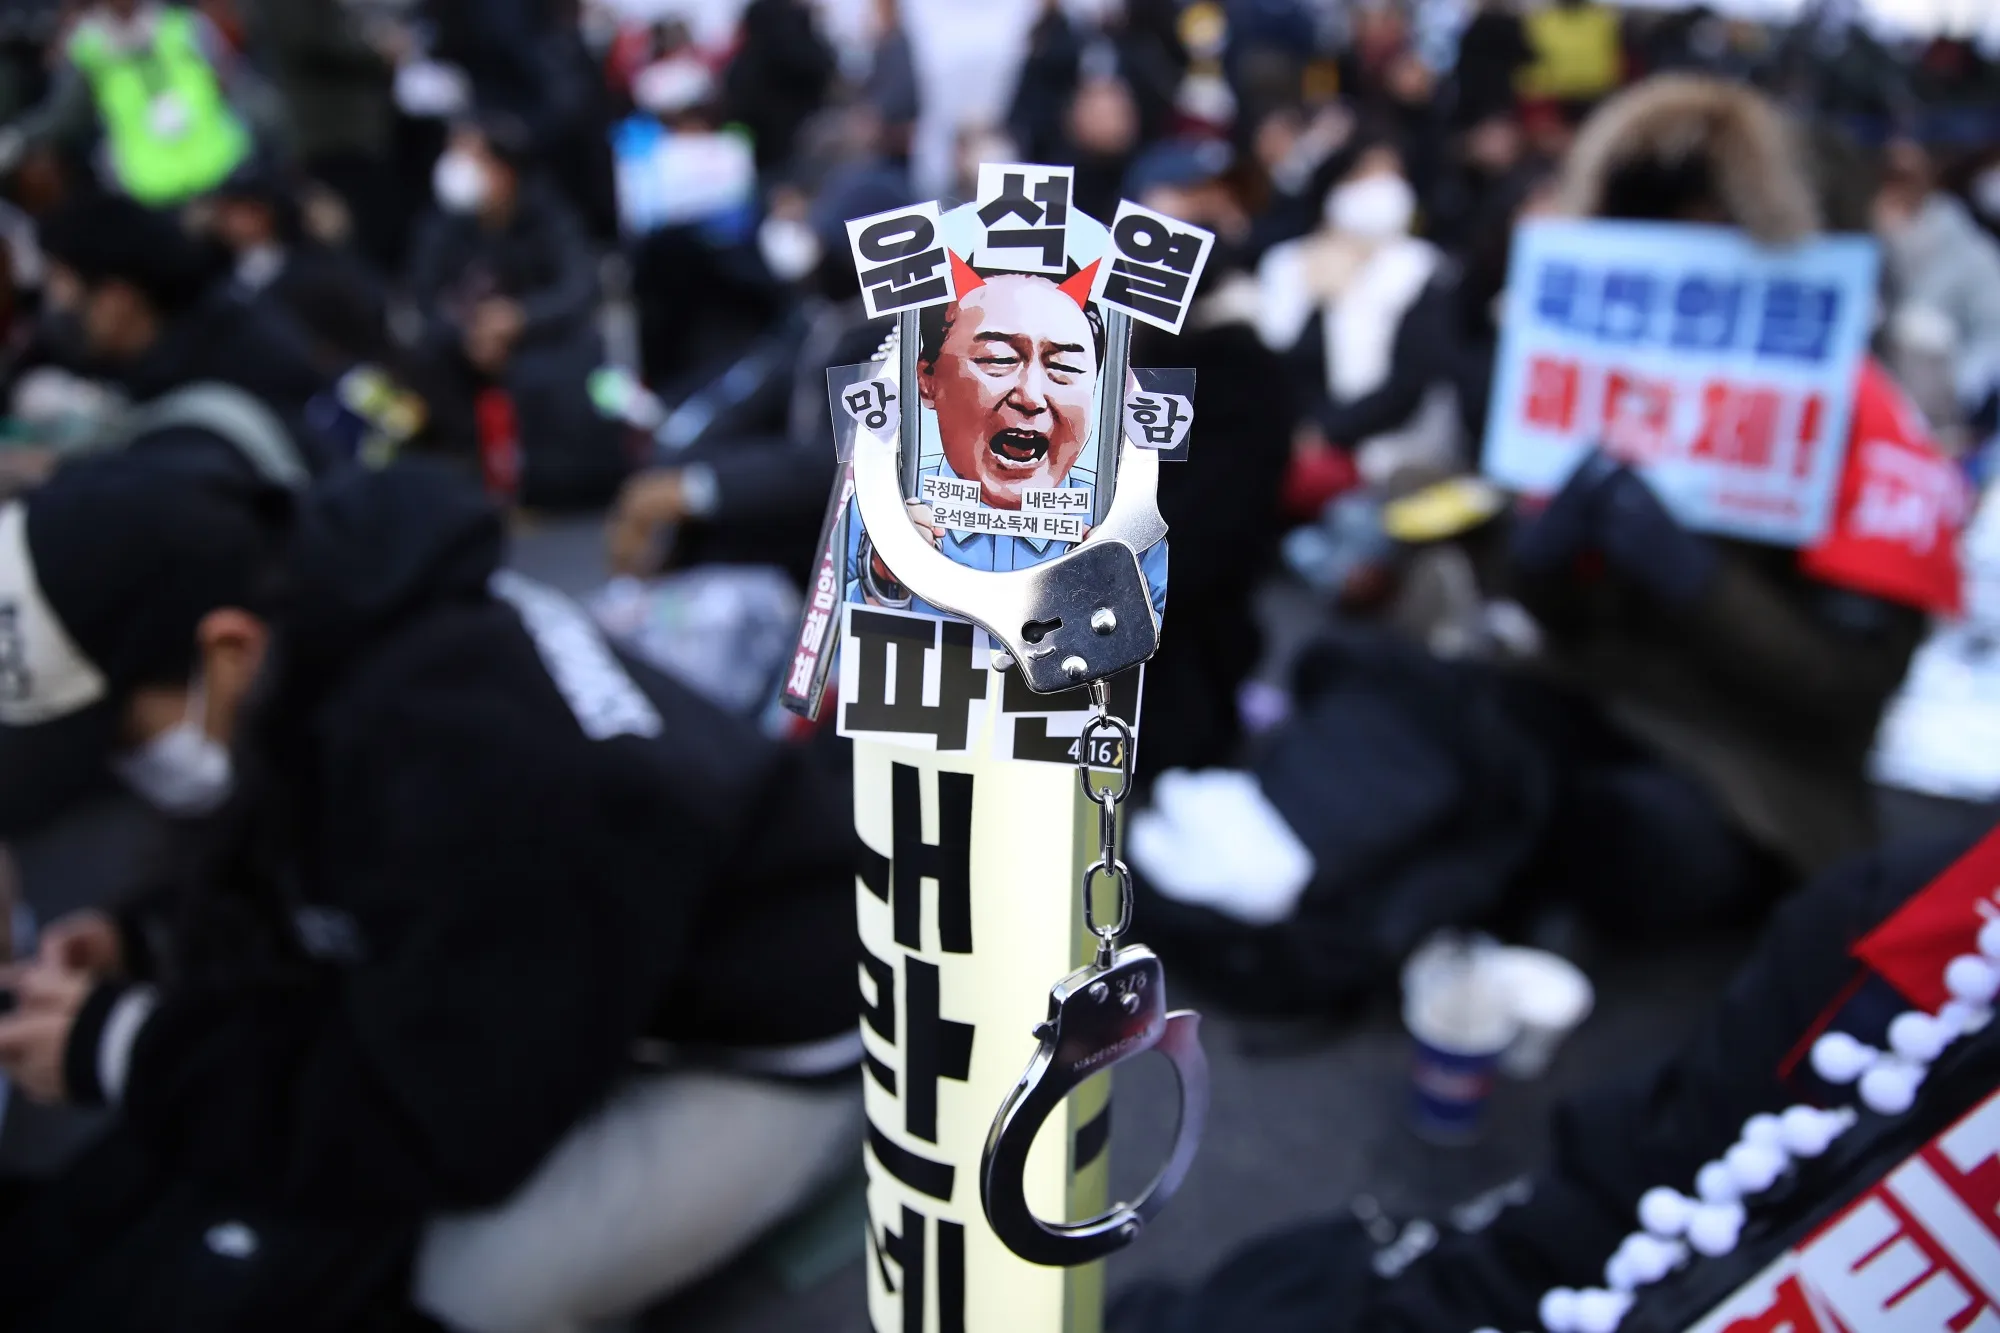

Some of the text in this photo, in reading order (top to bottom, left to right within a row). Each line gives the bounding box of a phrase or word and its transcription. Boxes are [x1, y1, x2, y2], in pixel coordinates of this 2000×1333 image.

[857, 172, 1203, 325] 윤석열
[923, 479, 980, 504] 국정파괴
[1026, 491, 1089, 510] 내란수괴
[933, 507, 1080, 537] 윤석열파쇼독재 타도!
